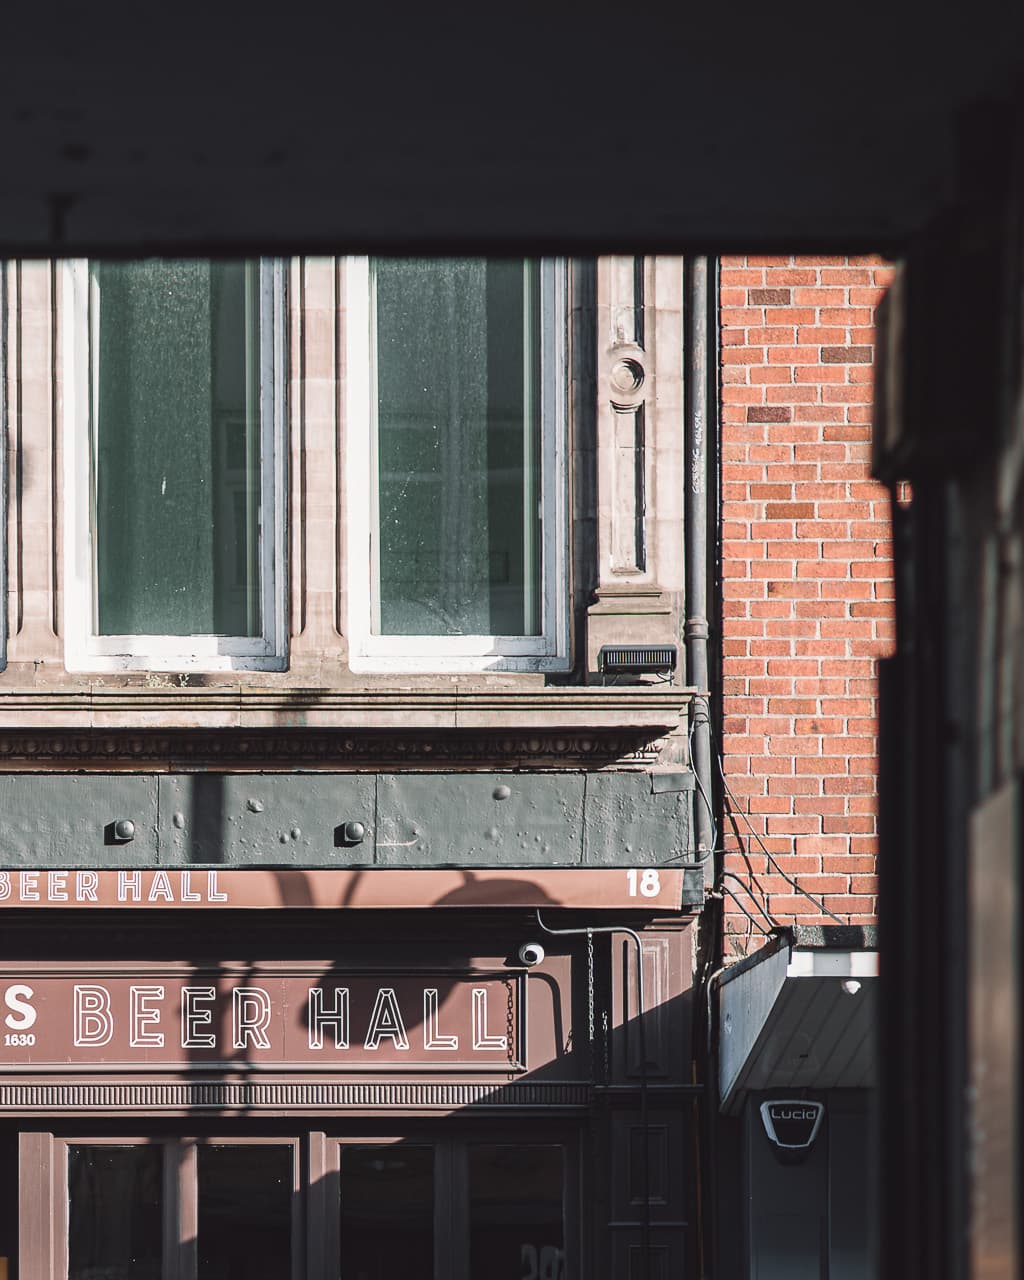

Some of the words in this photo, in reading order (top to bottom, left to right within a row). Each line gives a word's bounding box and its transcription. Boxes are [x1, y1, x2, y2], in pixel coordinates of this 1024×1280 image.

[117, 870, 228, 902] HALL
[626, 869, 661, 898] 18
[73, 985, 271, 1050] BEER
[308, 987, 508, 1051] HALL
[4, 1033, 36, 1047] 1630
